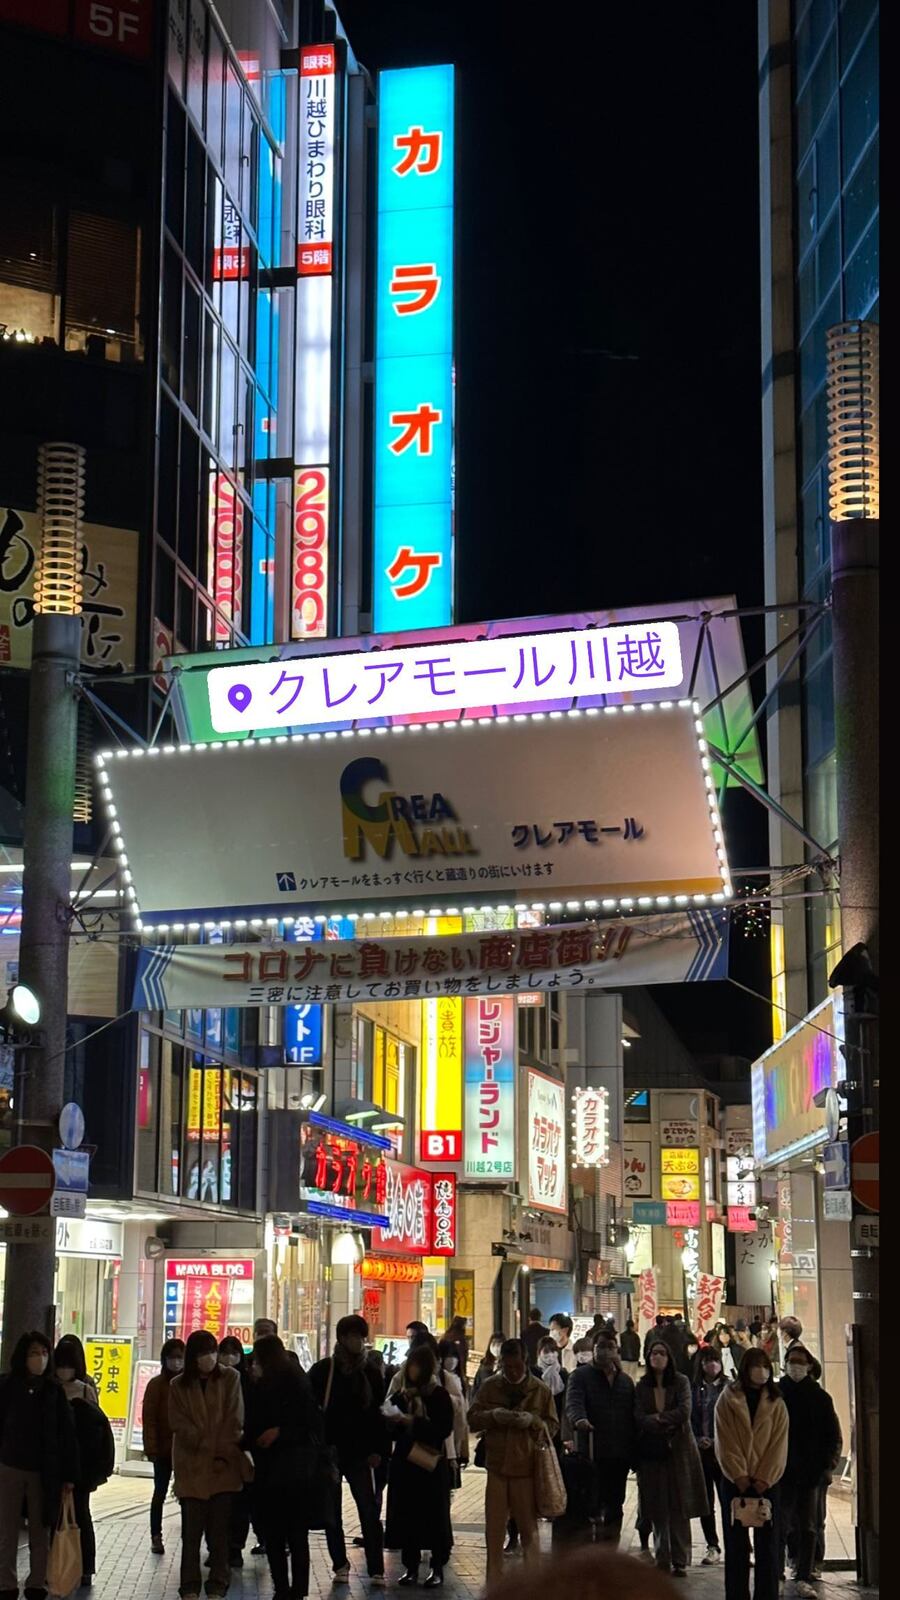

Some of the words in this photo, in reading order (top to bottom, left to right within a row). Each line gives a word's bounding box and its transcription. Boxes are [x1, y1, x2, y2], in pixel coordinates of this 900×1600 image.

[88, 3, 140, 42] 5F
[302, 55, 333, 70] 眼科
[305, 78, 327, 240] 川越ひまわり眼科
[301, 250, 330, 265] 5階
[387, 125, 444, 600] カラオケ
[340, 757, 458, 823] CREA
[511, 817, 645, 848] クレアモール
[300, 862, 555, 889] クレアモールをまっすぐ行くと蔵造りの街にいけます
[248, 968, 595, 1003] 三密に注意してお買い物をしましょう。
[290, 1047, 315, 1062] 1F
[479, 999, 501, 1154] レジャーランド
[583, 1097, 599, 1156] カラオケ
[427, 1135, 456, 1156] B1
[466, 1161, 513, 1174] 川越2号店
[663, 1161, 698, 1172] 天ぷら
[175, 1264, 208, 1276] MAYA
[211, 1264, 245, 1276] BLDG
[168, 1286, 176, 1297] 5
[168, 1309, 175, 1317] 4
[167, 1330, 174, 1340] 3
[106, 1365, 120, 1394] 中央
